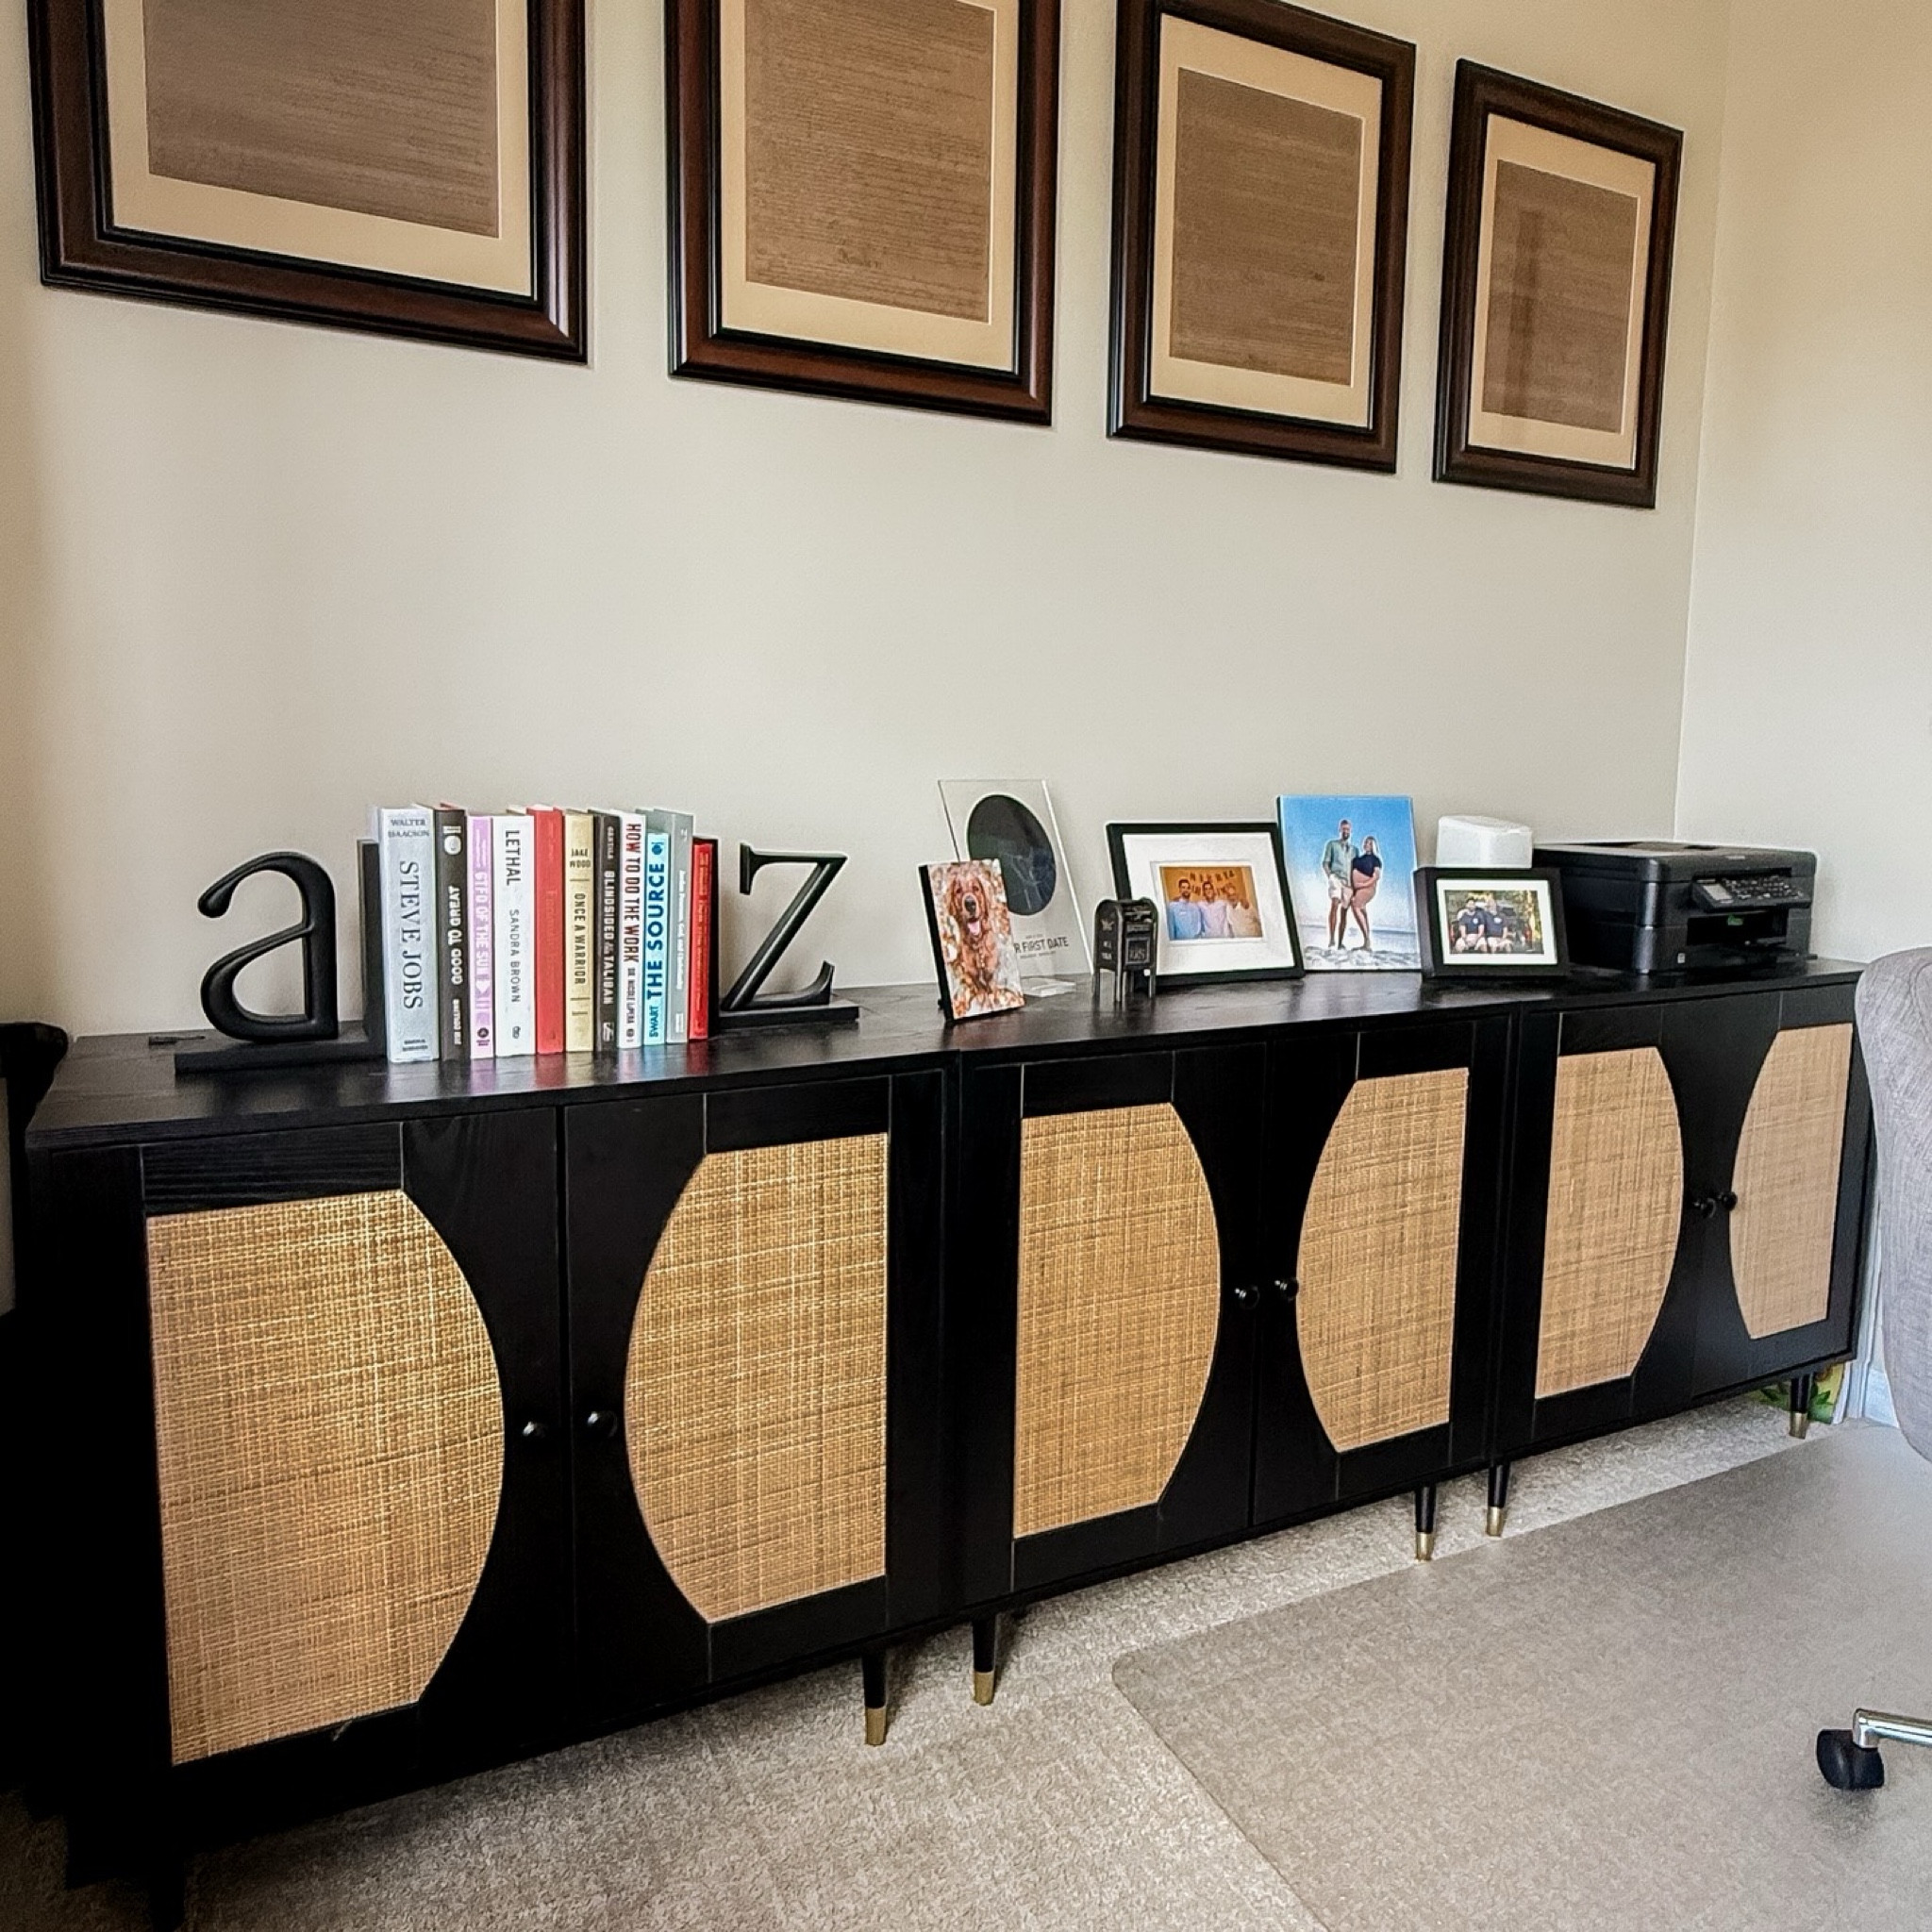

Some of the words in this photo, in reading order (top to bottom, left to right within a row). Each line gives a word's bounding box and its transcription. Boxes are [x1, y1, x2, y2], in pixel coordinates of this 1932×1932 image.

[390, 818, 426, 827] WALTER
[625, 823, 642, 854] HOW
[505, 829, 522, 887] LETHAL
[570, 859, 591, 869] WOOD
[624, 858, 641, 874] TO
[399, 860, 422, 943] STEVE
[624, 876, 641, 894] DO
[447, 885, 462, 926] GREAT
[574, 892, 587, 922] ONCE
[603, 870, 615, 940] BLINDSIDED
[624, 897, 641, 920] THE
[647, 862, 665, 951] SOURCE
[447, 929, 463, 945] TO
[475, 928, 490, 948] THE
[508, 908, 520, 957] SANDRA
[623, 924, 641, 963] WORK
[1047, 936, 1069, 949] DATE
[450, 949, 464, 986] GOOD
[574, 934, 587, 985] WARRIOR
[402, 949, 424, 1010] JOBS
[509, 960, 521, 1003] BROWN
[603, 955, 615, 1005] TALIBAN
[646, 959, 662, 1000] THE
[649, 1005, 659, 1039] SWART
